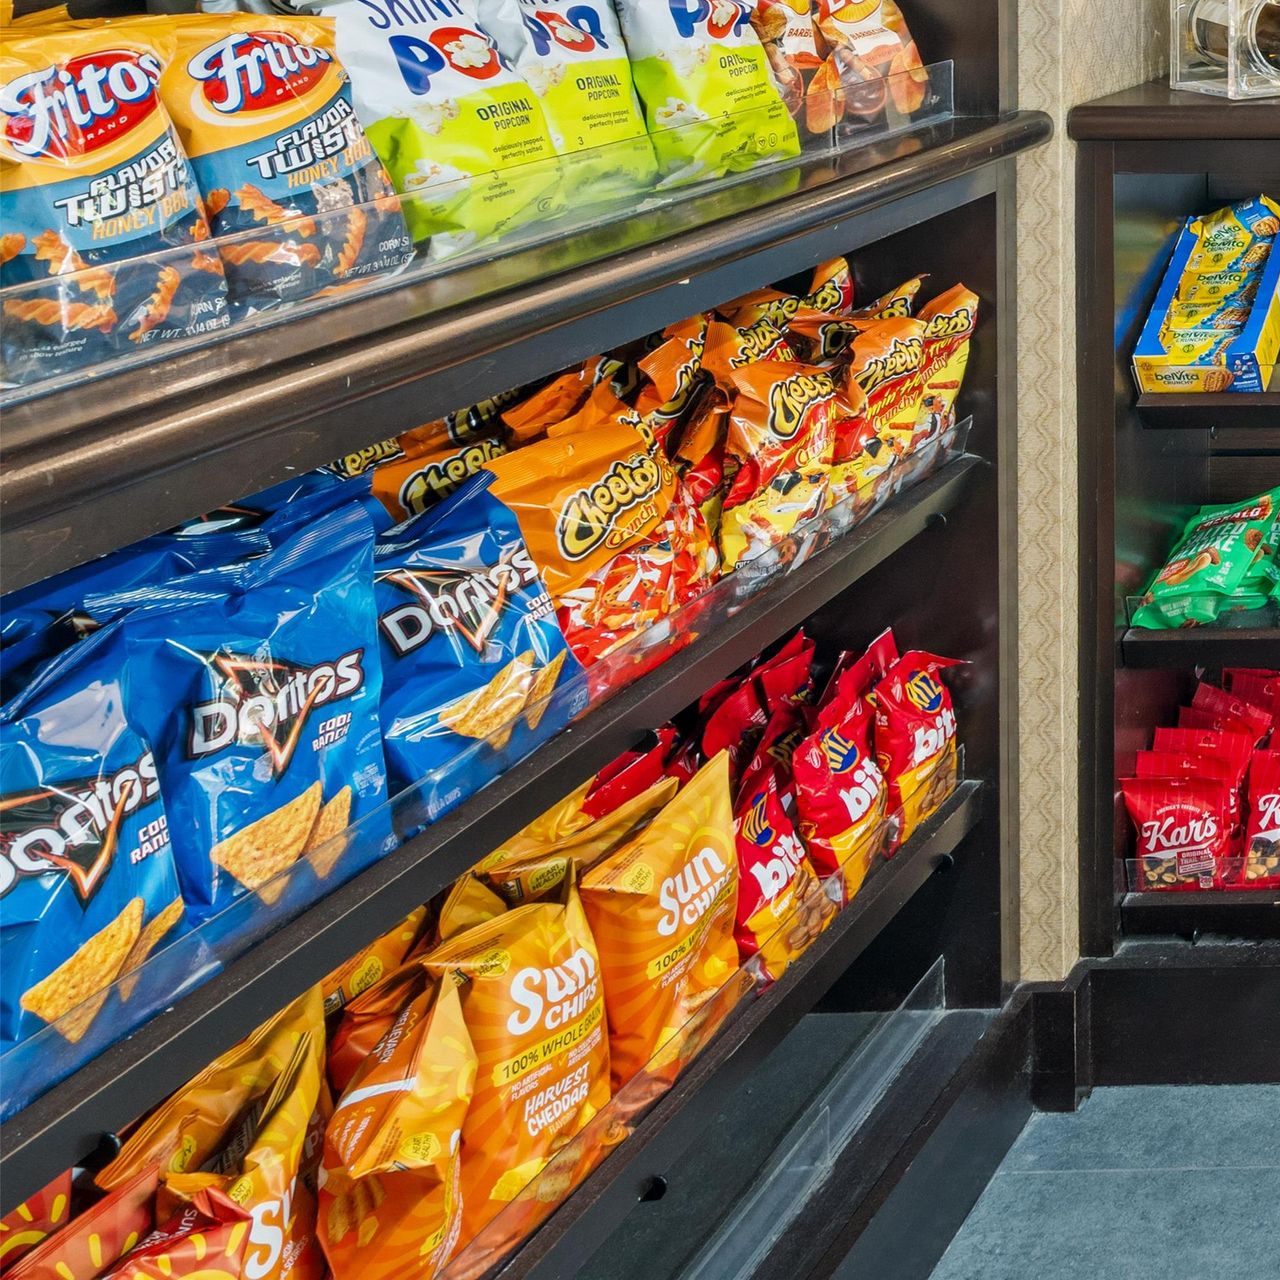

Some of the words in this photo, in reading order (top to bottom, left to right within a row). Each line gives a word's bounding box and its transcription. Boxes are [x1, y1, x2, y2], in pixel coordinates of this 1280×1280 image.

[189, 32, 333, 115] Fritos
[276, 75, 310, 96] BRAND
[576, 74, 621, 91] ORIGINAL
[587, 88, 620, 101] POPCORN
[729, 64, 760, 78] POPCORN
[1, 52, 164, 158] Fritos
[77, 115, 129, 145] BRAND
[276, 96, 352, 152] FLAVOR
[477, 97, 534, 121] ORIGINAL
[493, 115, 531, 132] POPCORN
[91, 135, 178, 198] FLAVOR
[287, 160, 339, 188] HONEY
[92, 207, 156, 242] HONEY
[557, 451, 662, 560] Cheetos
[606, 499, 658, 549] Crunchy
[384, 549, 538, 656] Doritos
[193, 650, 364, 757] Doritos
[905, 671, 942, 709] RITZ
[312, 726, 350, 753] RANCH
[318, 712, 352, 735] COOL
[656, 846, 727, 936] Sun
[655, 942, 688, 971] 100%
[507, 946, 597, 1036] Sun
[544, 977, 597, 1030] CHIPS
[502, 1050, 539, 1080] 100%
[541, 1027, 583, 1059] WHOLE
[523, 1061, 592, 1122] HARVEST
[527, 1081, 591, 1137] CHEDDAR
